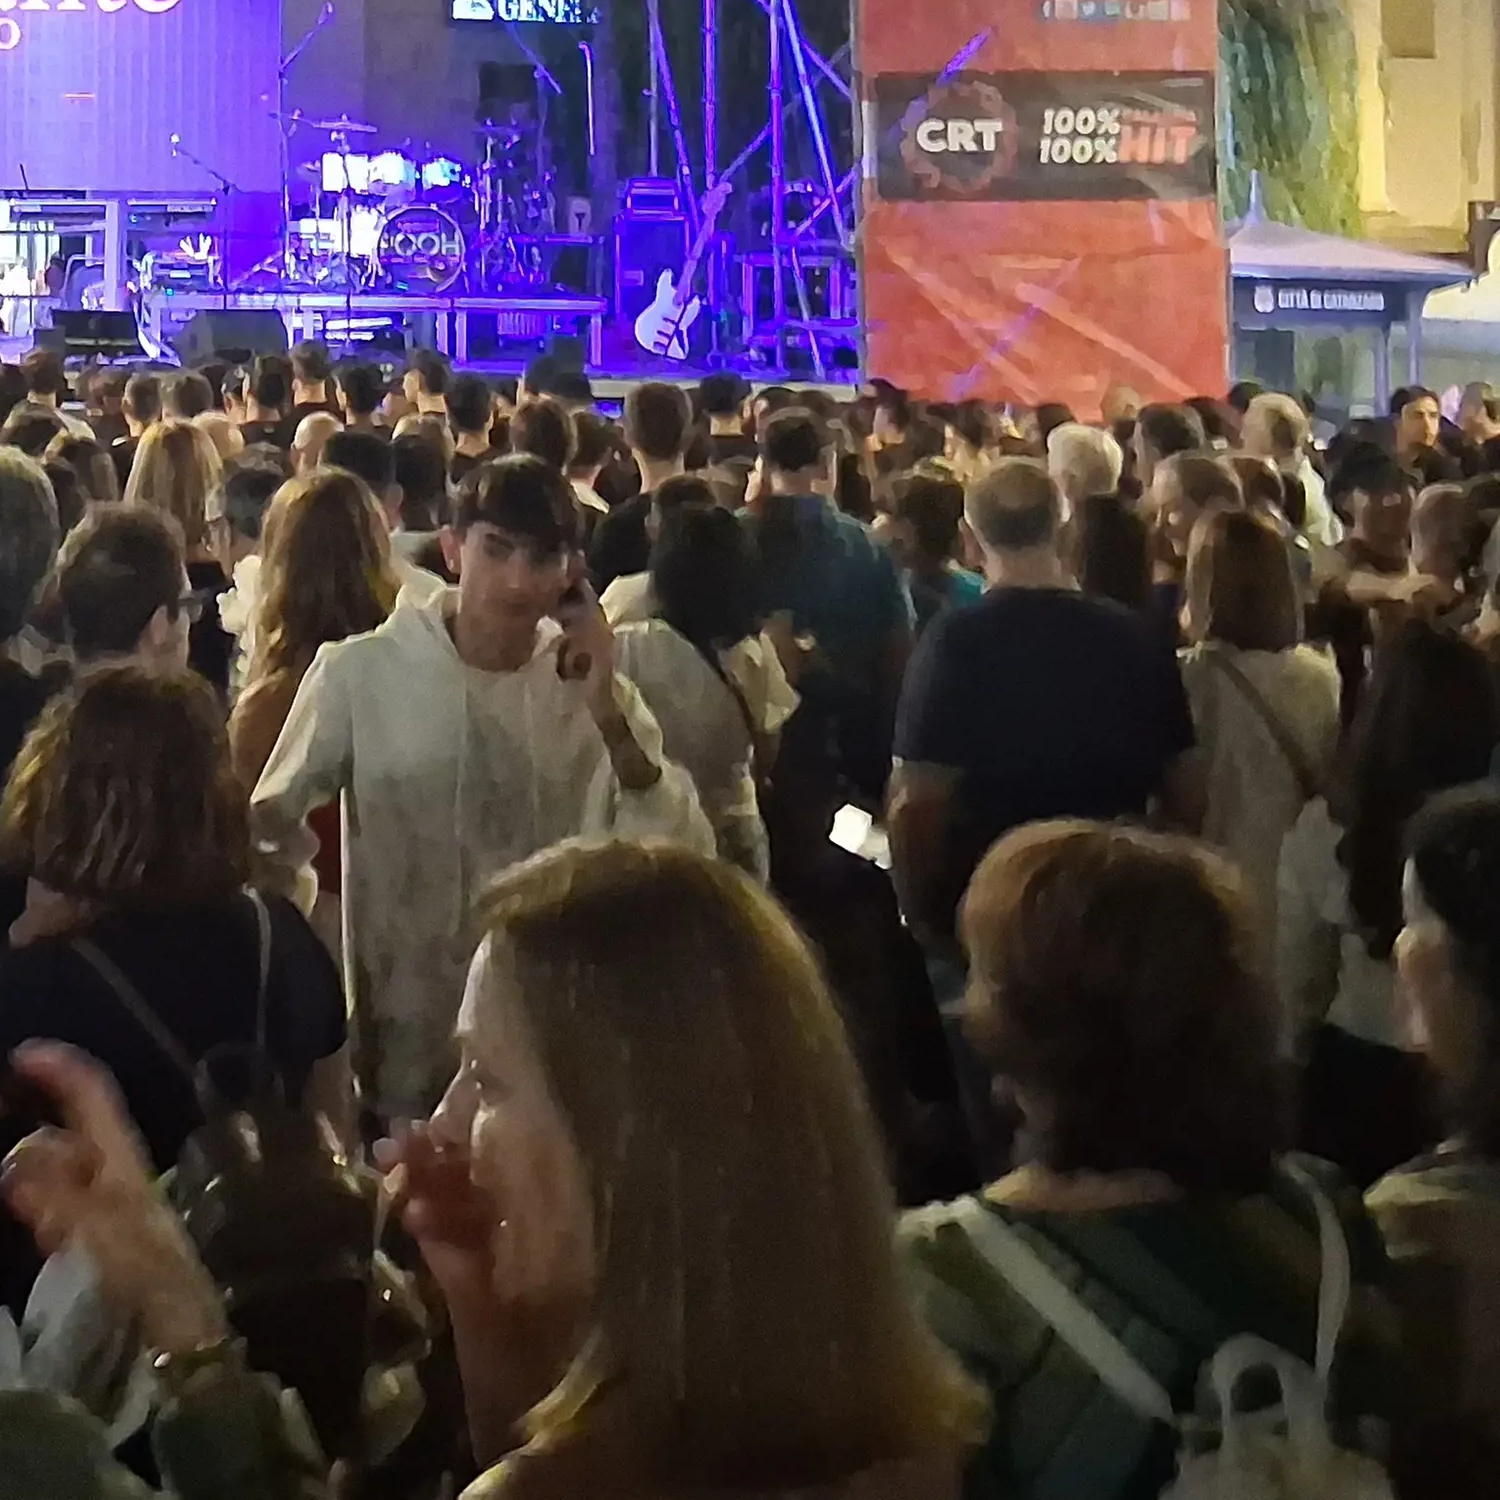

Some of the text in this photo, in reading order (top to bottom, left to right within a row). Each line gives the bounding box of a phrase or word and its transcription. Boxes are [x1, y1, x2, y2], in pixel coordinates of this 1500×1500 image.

[916, 117, 1004, 153] CRT
[1043, 106, 1120, 136] 100%
[1039, 125, 1196, 164] 100% HIT
